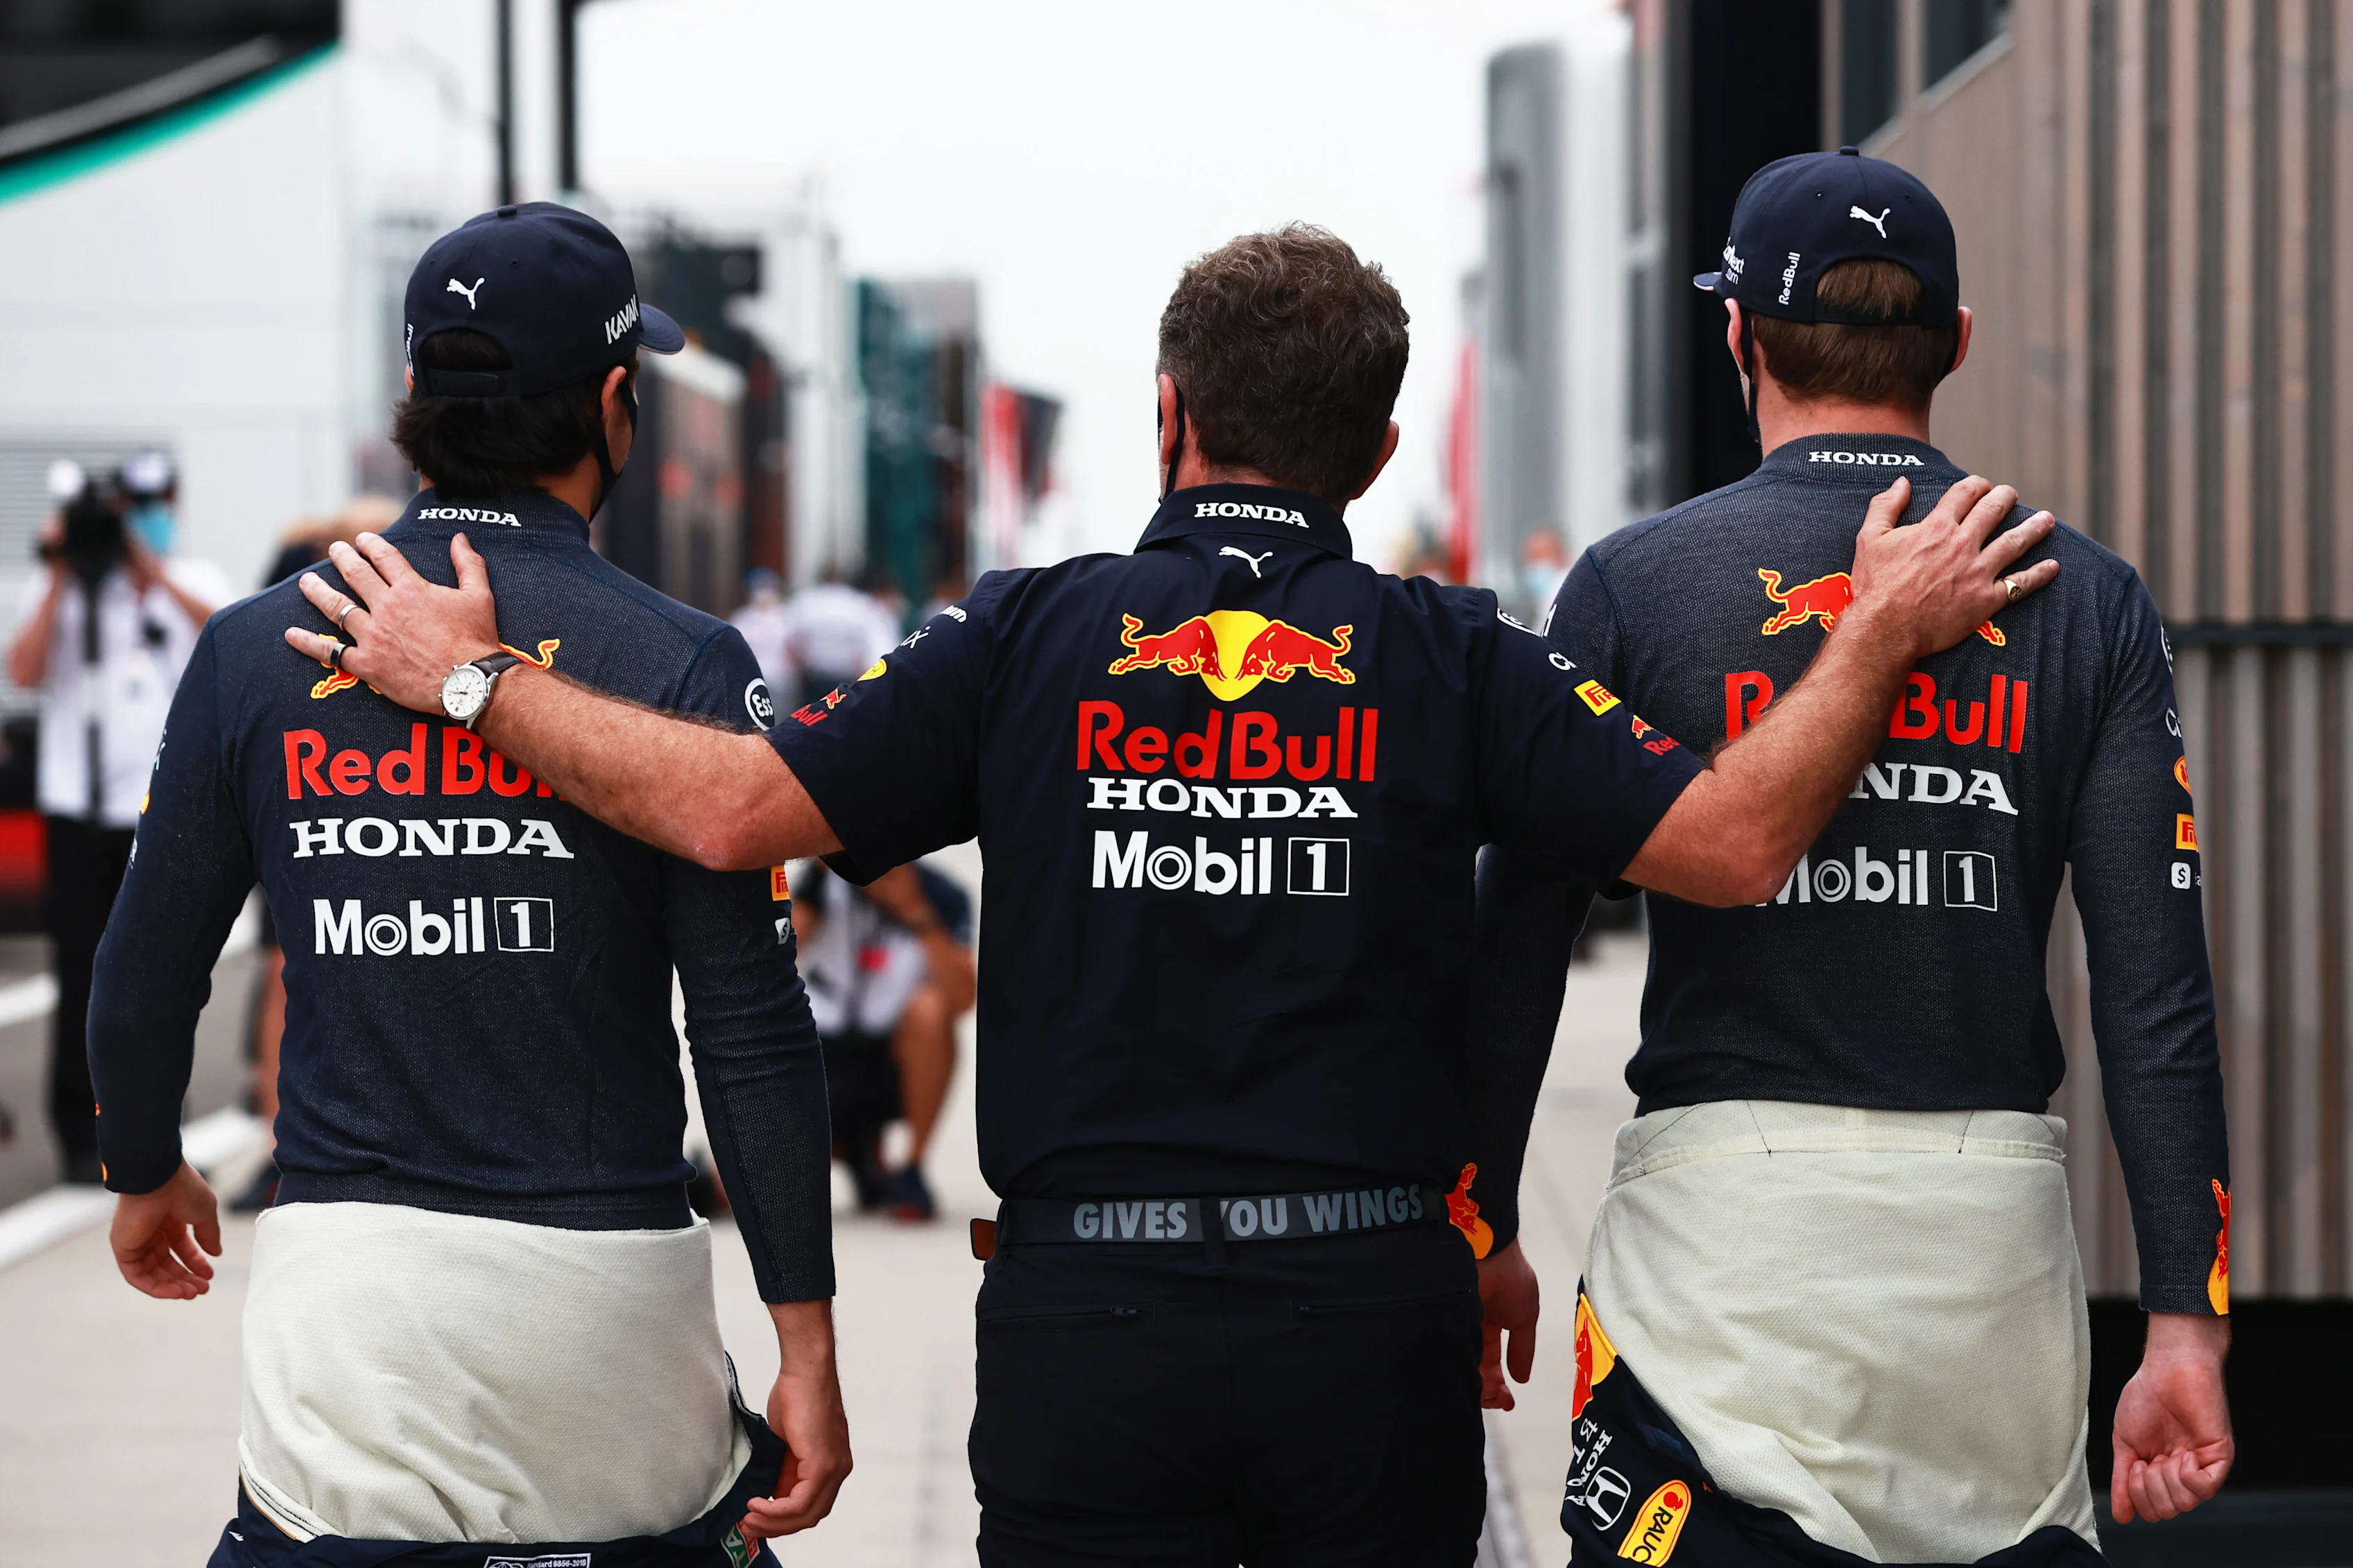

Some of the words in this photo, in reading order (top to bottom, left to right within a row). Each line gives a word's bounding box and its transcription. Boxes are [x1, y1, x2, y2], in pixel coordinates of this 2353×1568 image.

[1808, 451, 1925, 466] HONDA
[418, 508, 522, 527] HONDA
[1194, 502, 1310, 528] HONDA
[751, 693, 773, 718] Ess
[1889, 671, 2028, 754] Bull
[283, 722, 427, 800] Red
[441, 725, 566, 801] Bu
[1087, 777, 1359, 819] HONDA
[1849, 762, 2019, 816] NDA
[289, 816, 575, 859] HONDA
[1092, 829, 1273, 895] Mobil
[313, 896, 486, 956] Mobil
[1073, 1202, 1187, 1239] GIVES
[1302, 1183, 1423, 1233] WINGS
[1632, 1506, 1674, 1563] RAUC
